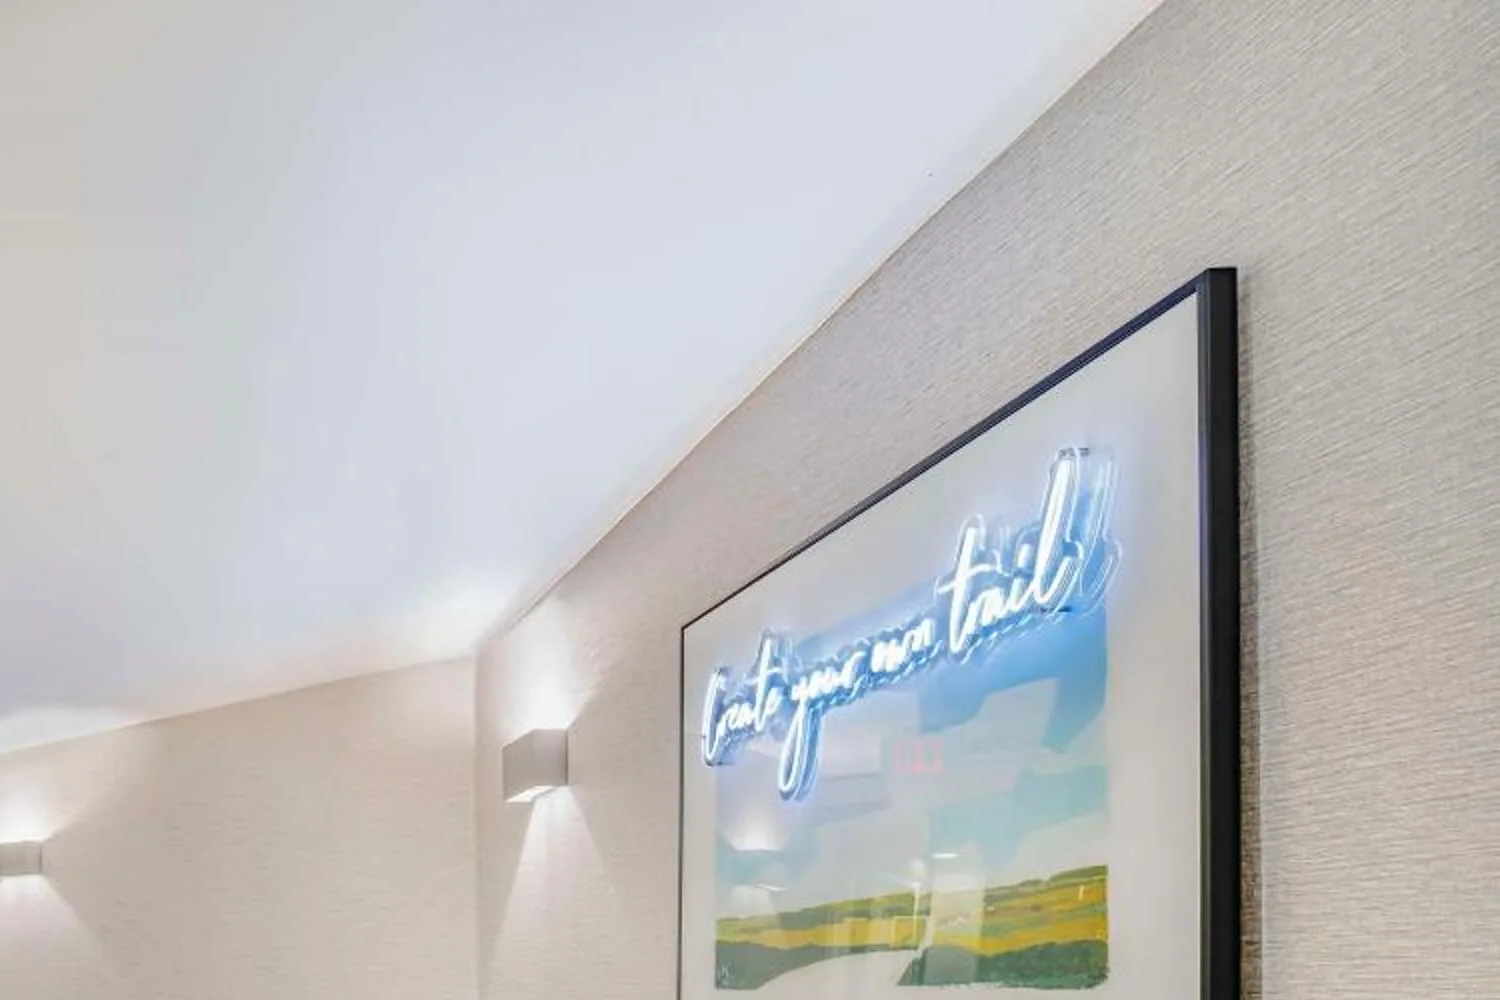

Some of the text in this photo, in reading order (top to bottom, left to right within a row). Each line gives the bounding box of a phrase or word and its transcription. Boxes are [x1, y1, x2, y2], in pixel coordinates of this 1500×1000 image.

[701, 458, 1073, 792] Create your own trail
